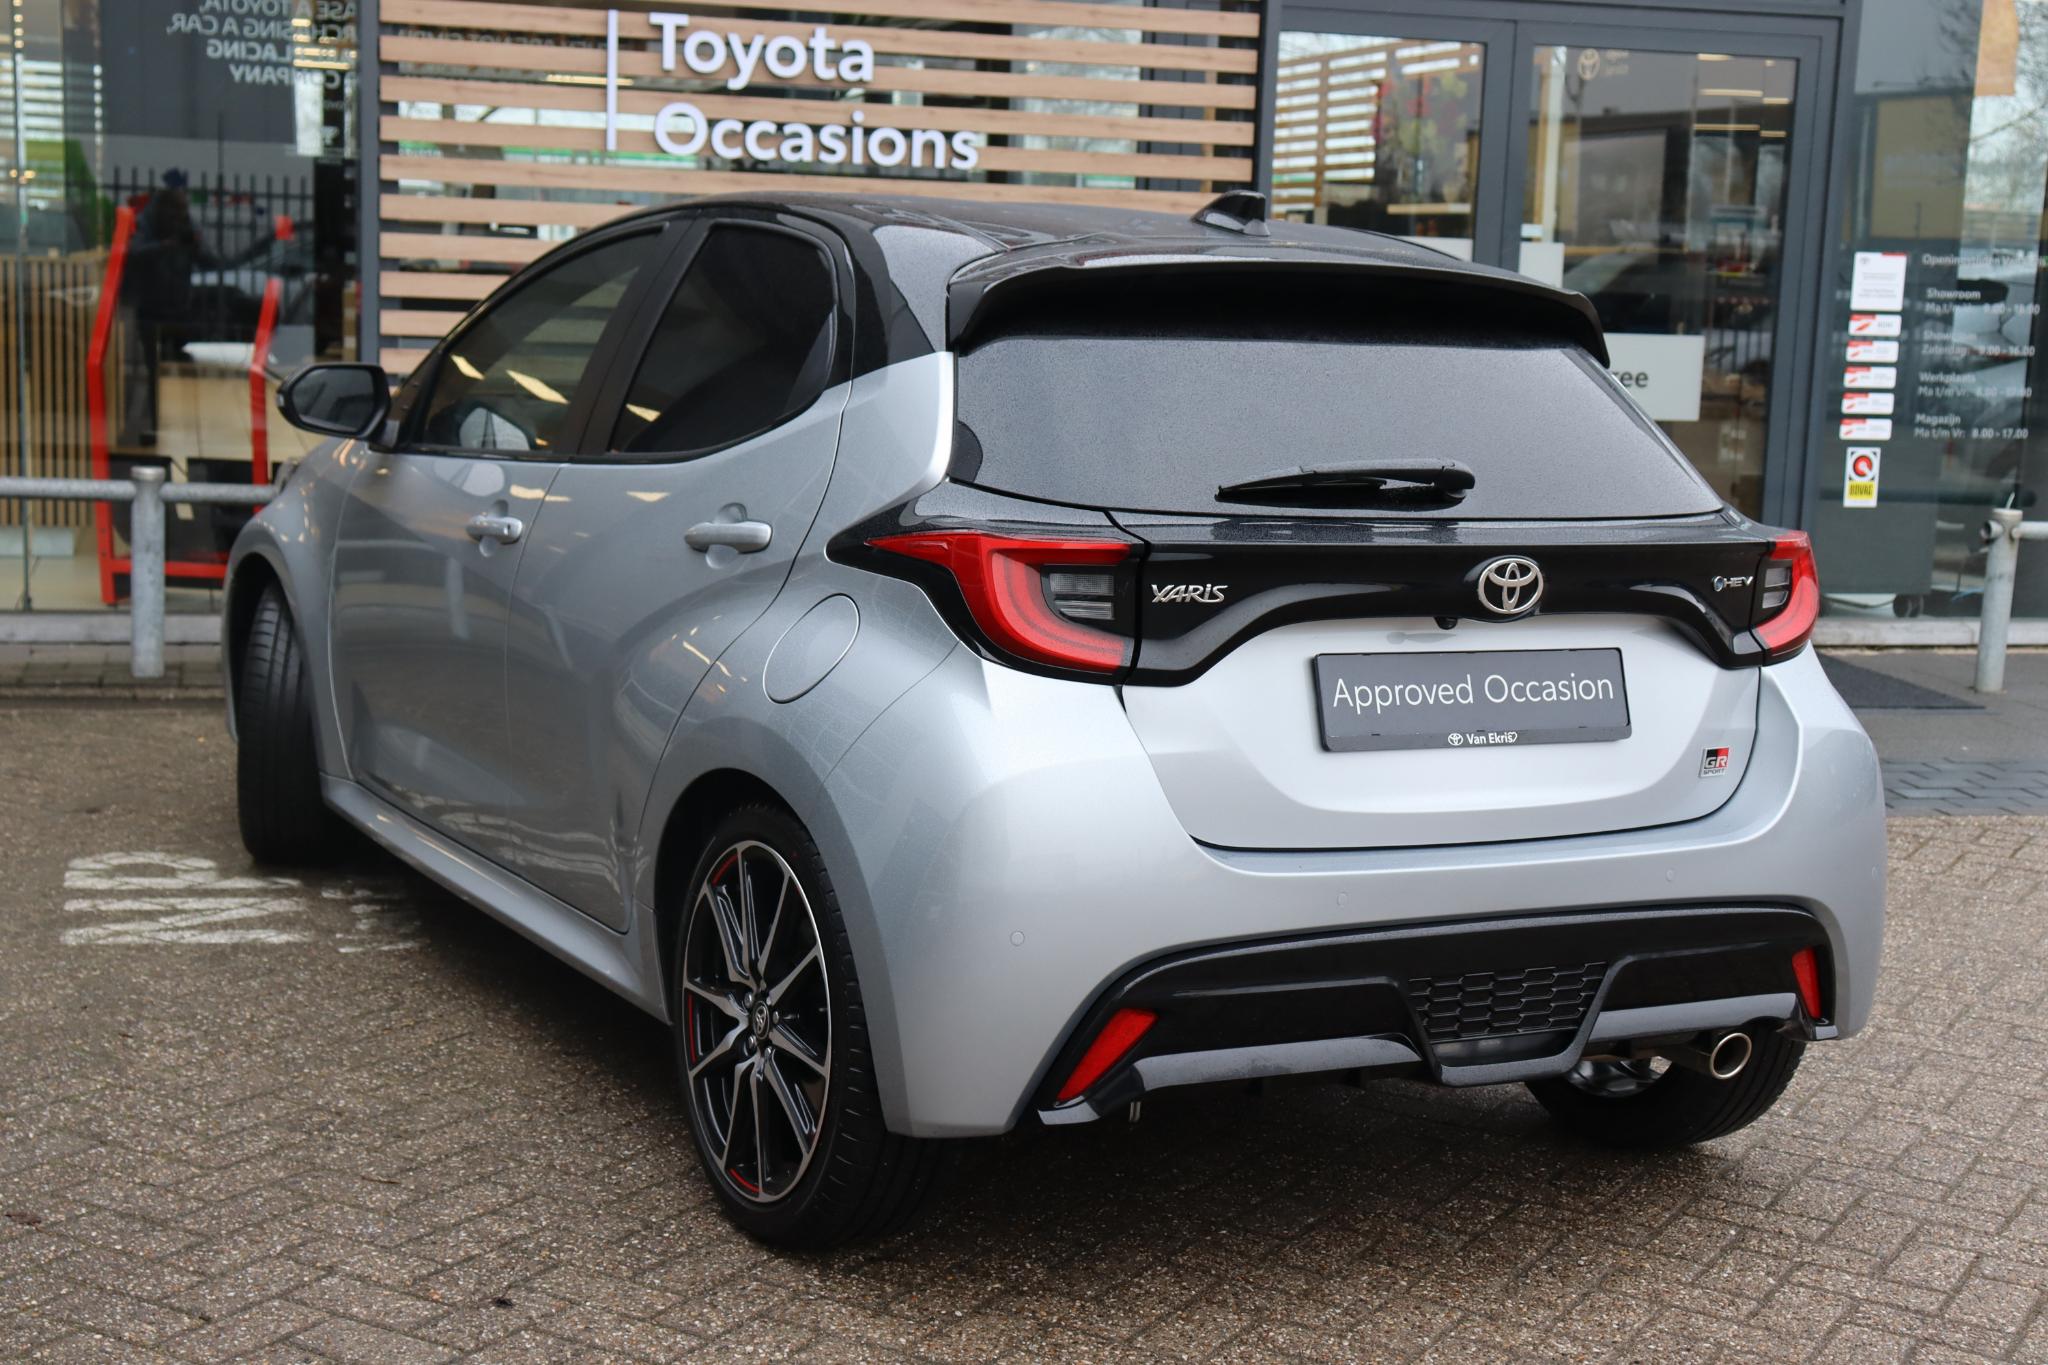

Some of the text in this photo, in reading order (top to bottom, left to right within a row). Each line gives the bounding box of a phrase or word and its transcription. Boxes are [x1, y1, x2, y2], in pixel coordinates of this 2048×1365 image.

[648, 12, 875, 91] Toyota
[654, 102, 980, 170] Occasions
[1926, 287, 1981, 300] Showroom
[1915, 413, 1961, 426] Magazijn
[1332, 672, 1614, 715] Approved Occasion
[1465, 731, 1513, 745] Van Ekris
[1705, 755, 1728, 769] GR
